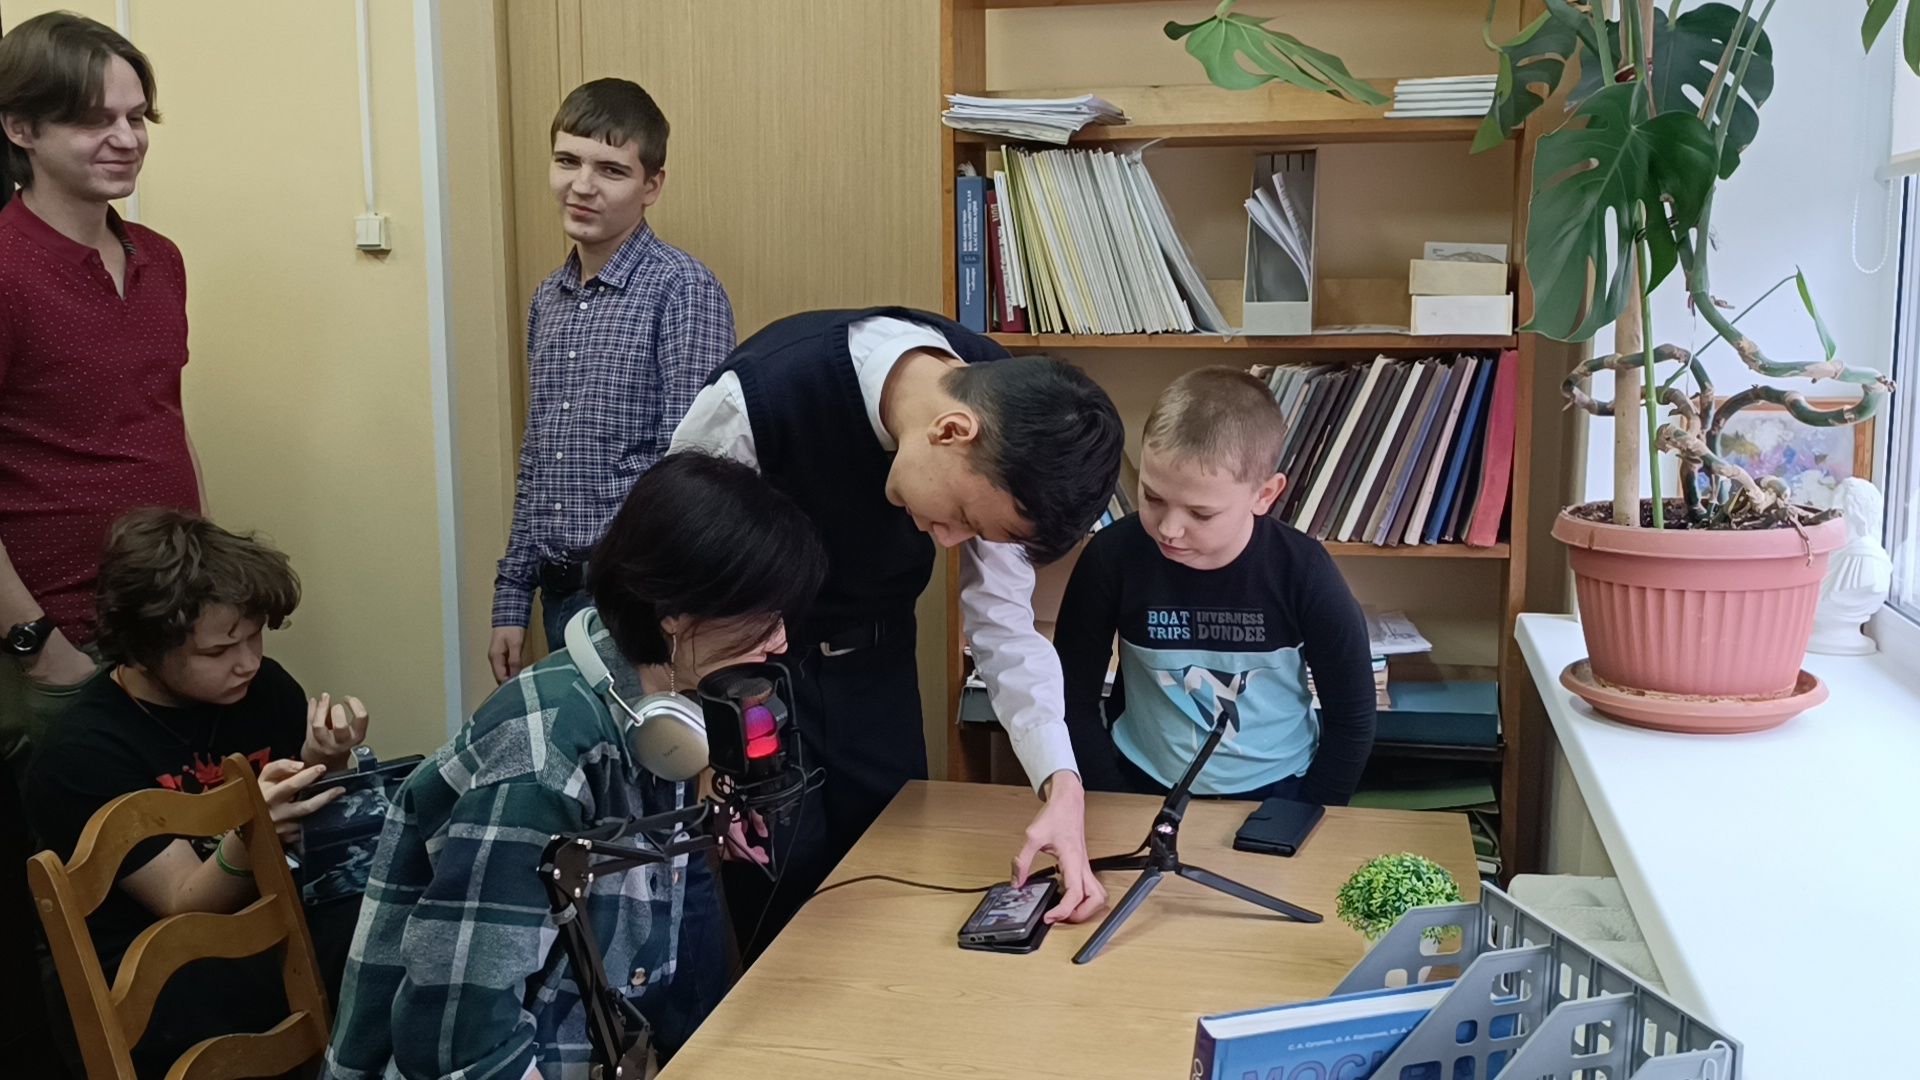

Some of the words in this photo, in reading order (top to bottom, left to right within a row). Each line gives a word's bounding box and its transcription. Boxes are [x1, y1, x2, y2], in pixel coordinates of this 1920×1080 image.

[1147, 610, 1190, 625] BOAT
[1196, 611, 1265, 625] INVERNESS
[1147, 626, 1192, 640] TRIPS
[1197, 624, 1266, 642] DUNDEE
